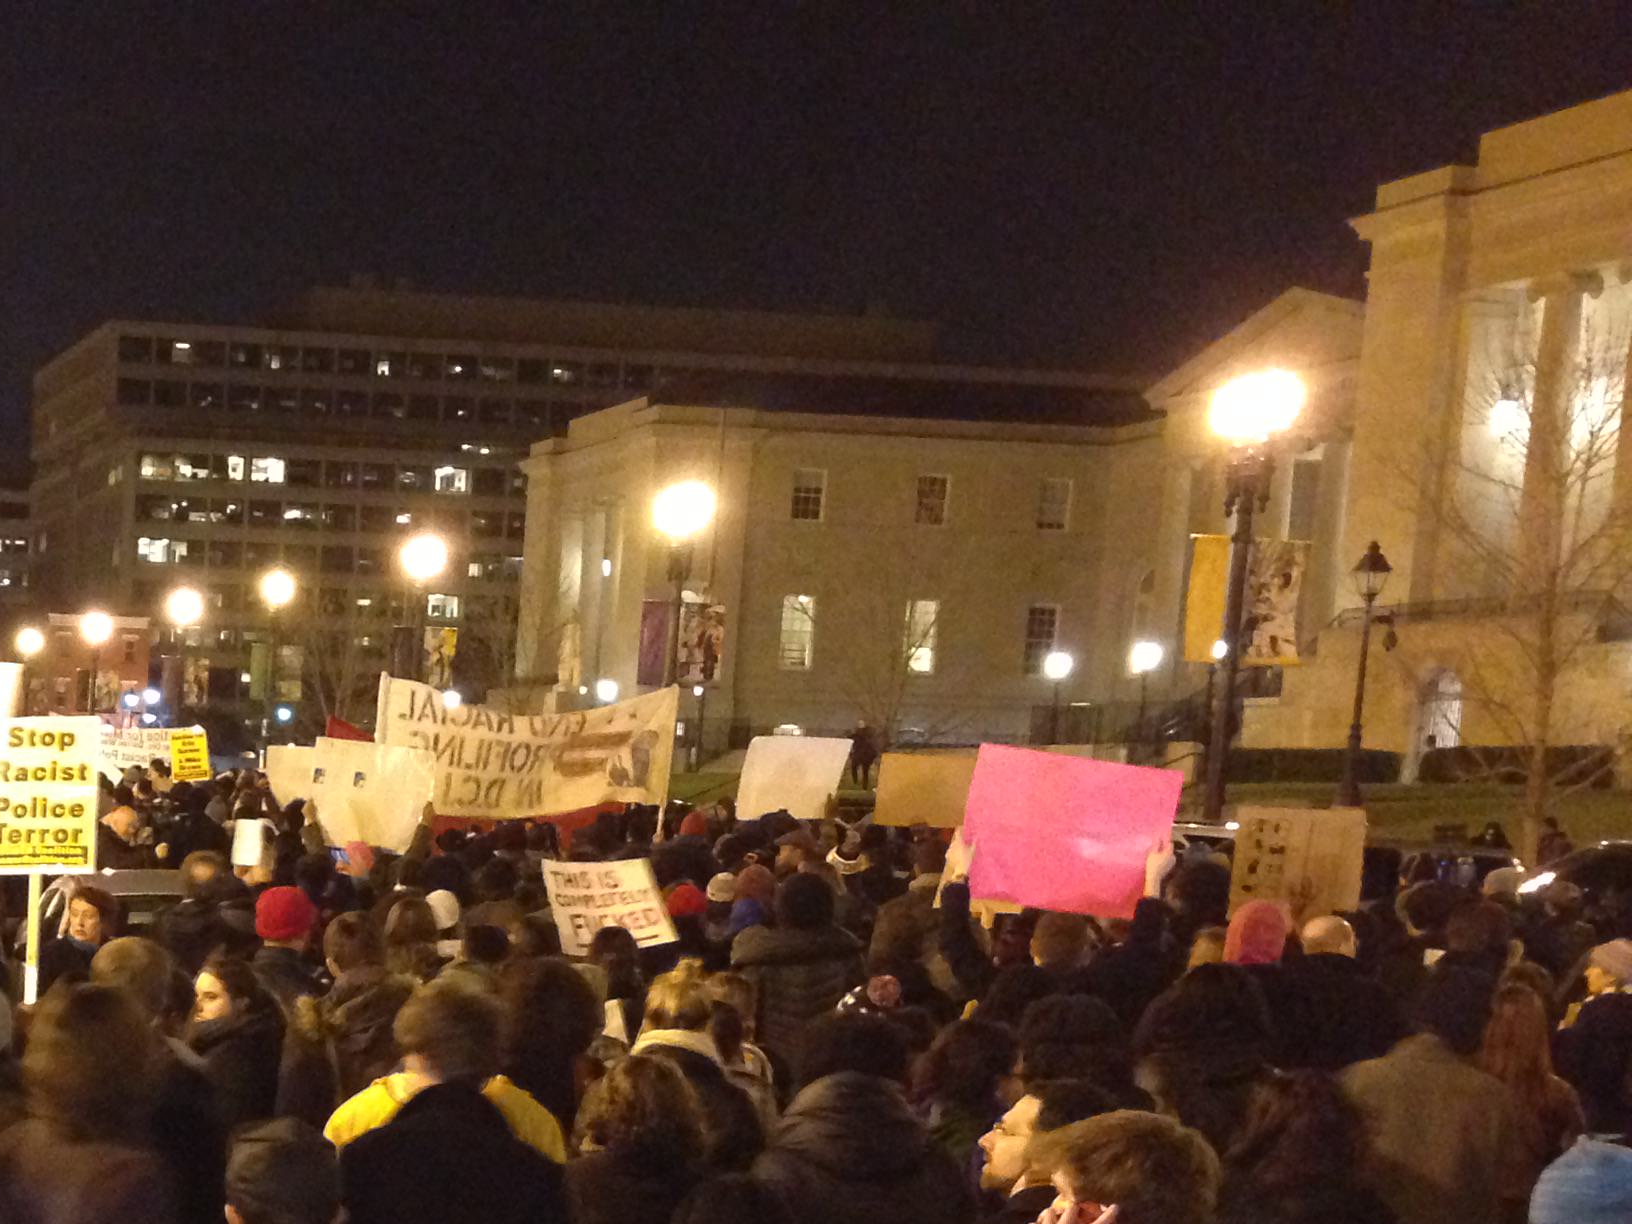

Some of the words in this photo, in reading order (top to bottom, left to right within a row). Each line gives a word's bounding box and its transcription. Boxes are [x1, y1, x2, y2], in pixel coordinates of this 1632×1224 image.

[9, 727, 75, 751] Stop
[550, 871, 591, 889] THIS
[597, 870, 620, 889] IS
